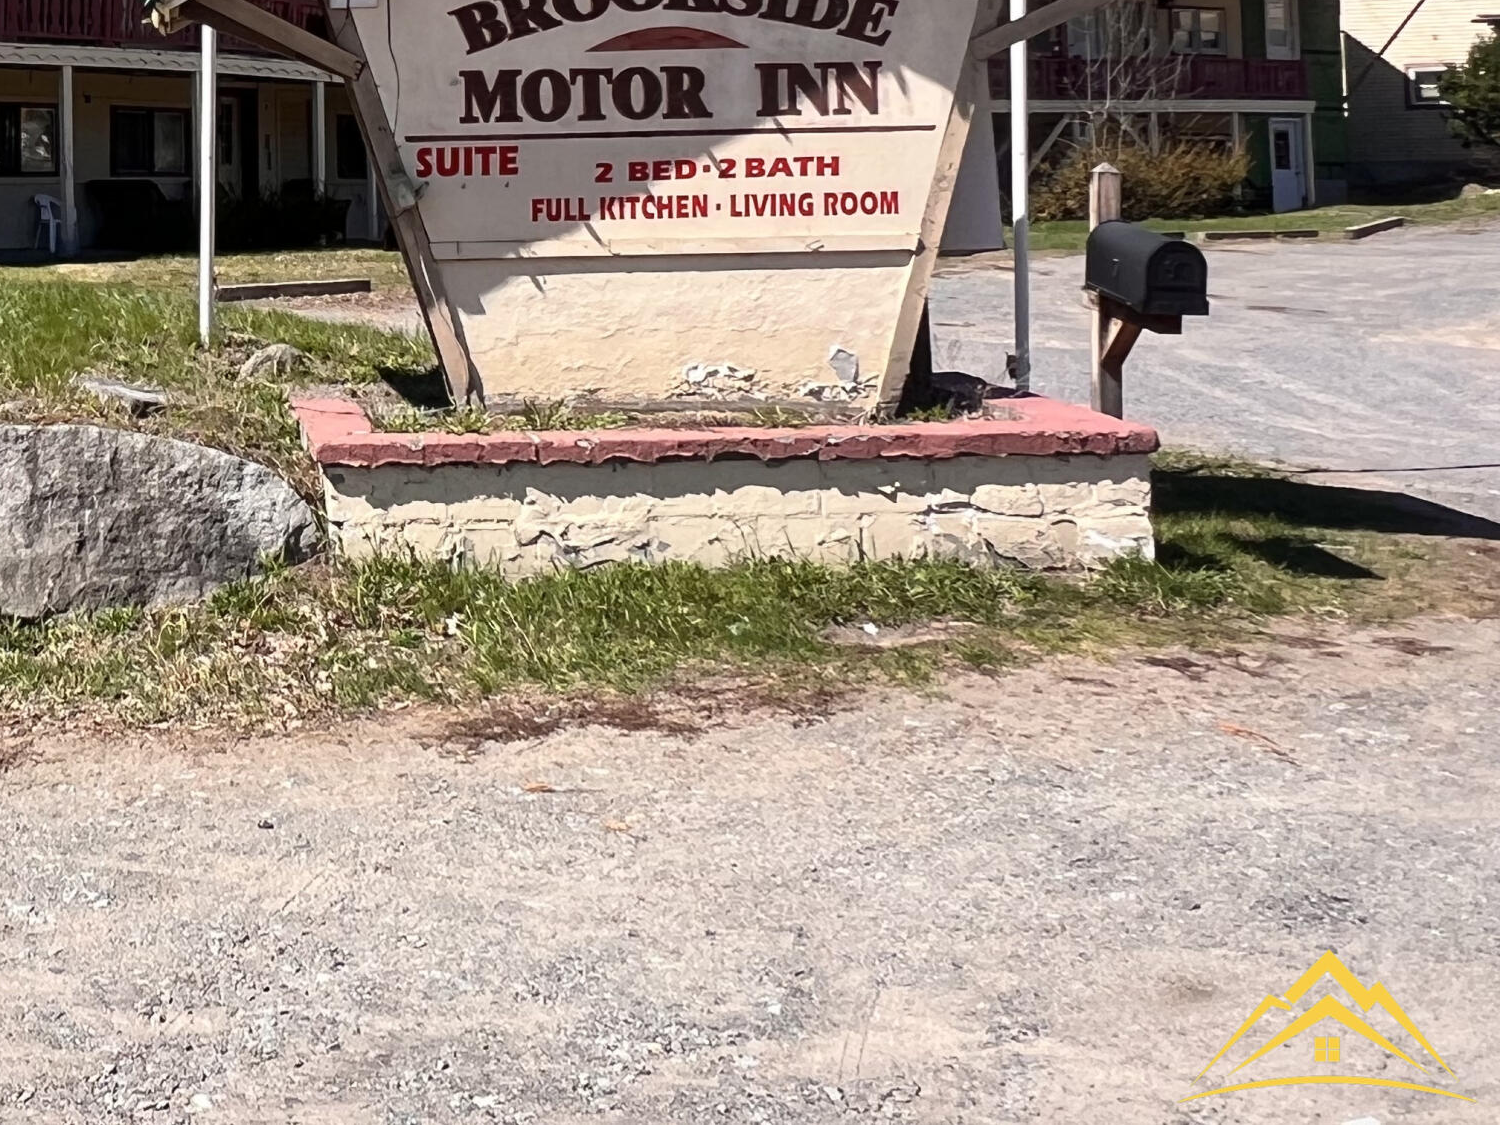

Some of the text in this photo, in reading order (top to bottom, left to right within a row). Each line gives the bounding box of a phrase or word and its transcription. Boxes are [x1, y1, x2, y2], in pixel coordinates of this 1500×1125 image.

[458, 60, 883, 125] MOTOR INN
[415, 145, 520, 178] SUITE
[594, 156, 841, 183] 2 BED 2 BATH
[531, 190, 900, 222] FULL KITCHEN LIVING ROOM
